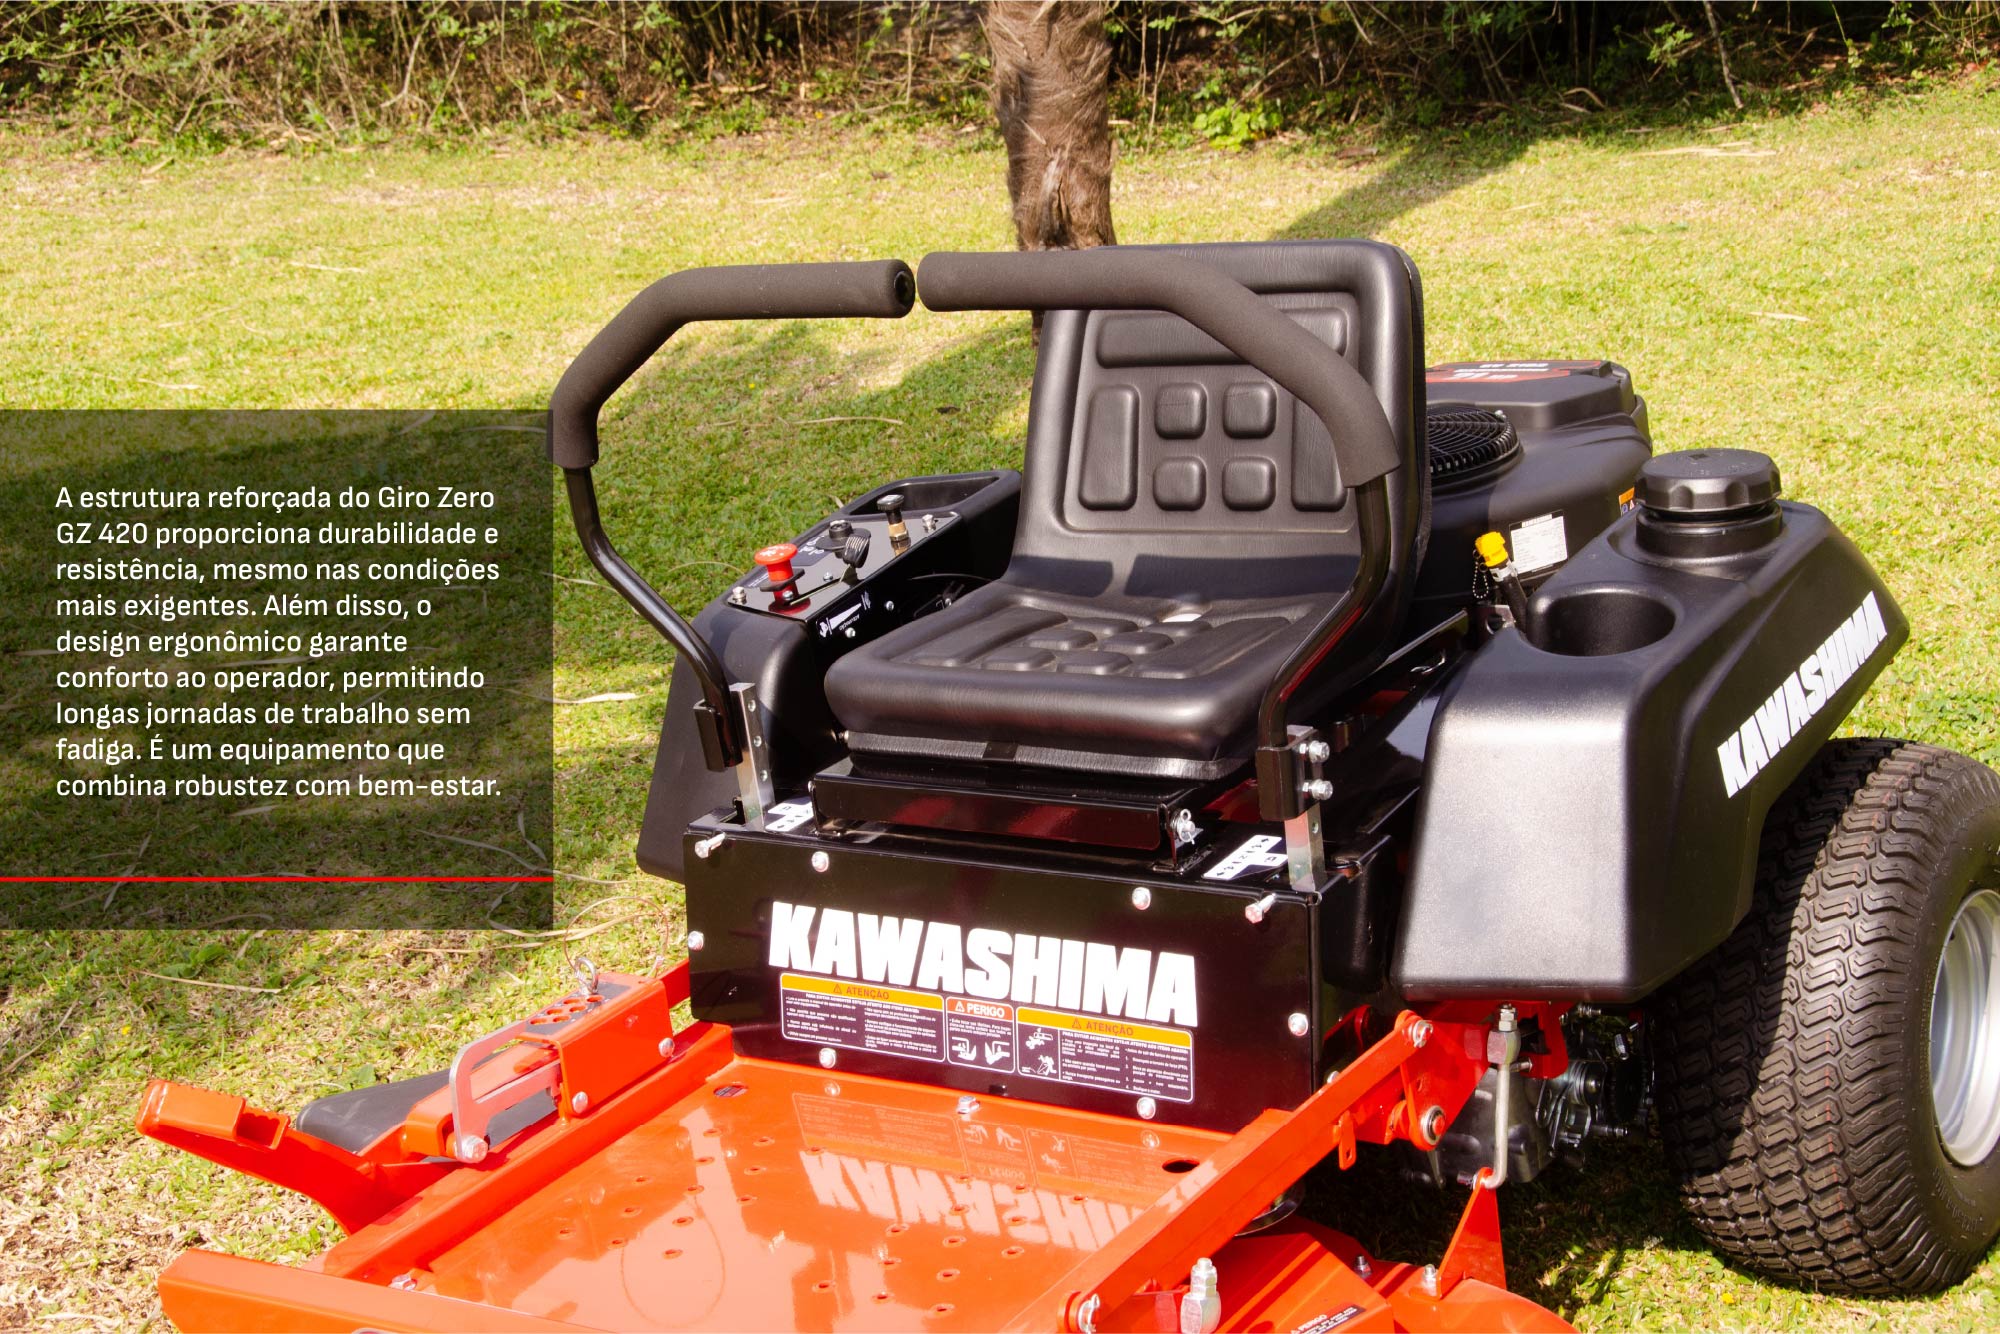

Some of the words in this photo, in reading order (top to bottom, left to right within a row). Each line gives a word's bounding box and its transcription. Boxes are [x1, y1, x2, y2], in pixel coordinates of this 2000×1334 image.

[1716, 590, 1888, 799] KAWASHIMA
[768, 901, 1198, 1027] KAWASHIMA
[846, 985, 890, 1000] ATENÇÃO
[966, 1002, 1005, 1019] PERIGO
[1085, 1020, 1134, 1037] ATENÇÃO
